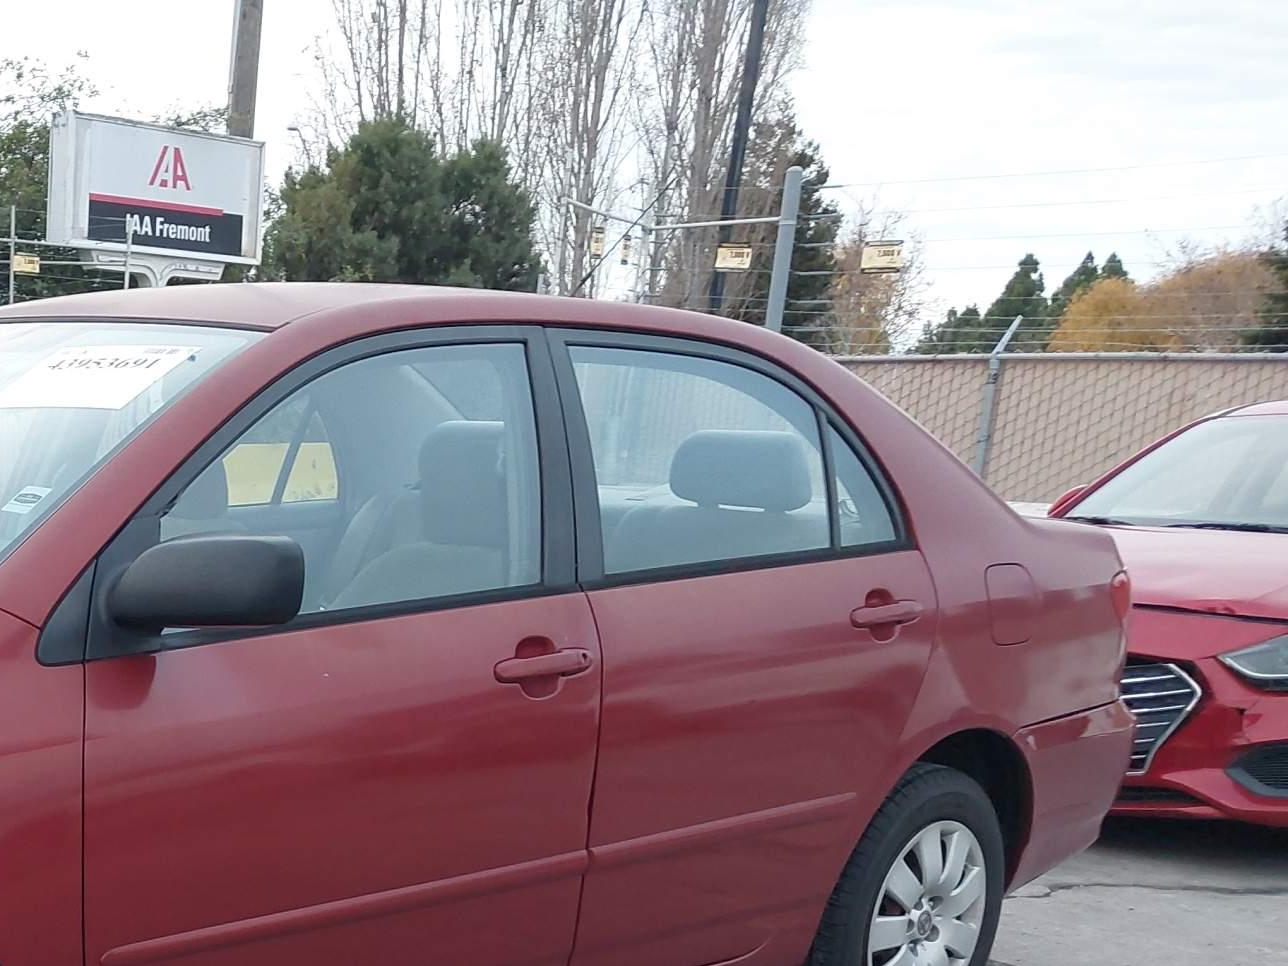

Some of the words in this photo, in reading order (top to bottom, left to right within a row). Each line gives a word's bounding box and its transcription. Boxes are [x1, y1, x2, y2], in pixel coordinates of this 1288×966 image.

[125, 212, 152, 236] IAA
[154, 216, 211, 243] Fremont
[47, 357, 162, 371] 43953691
